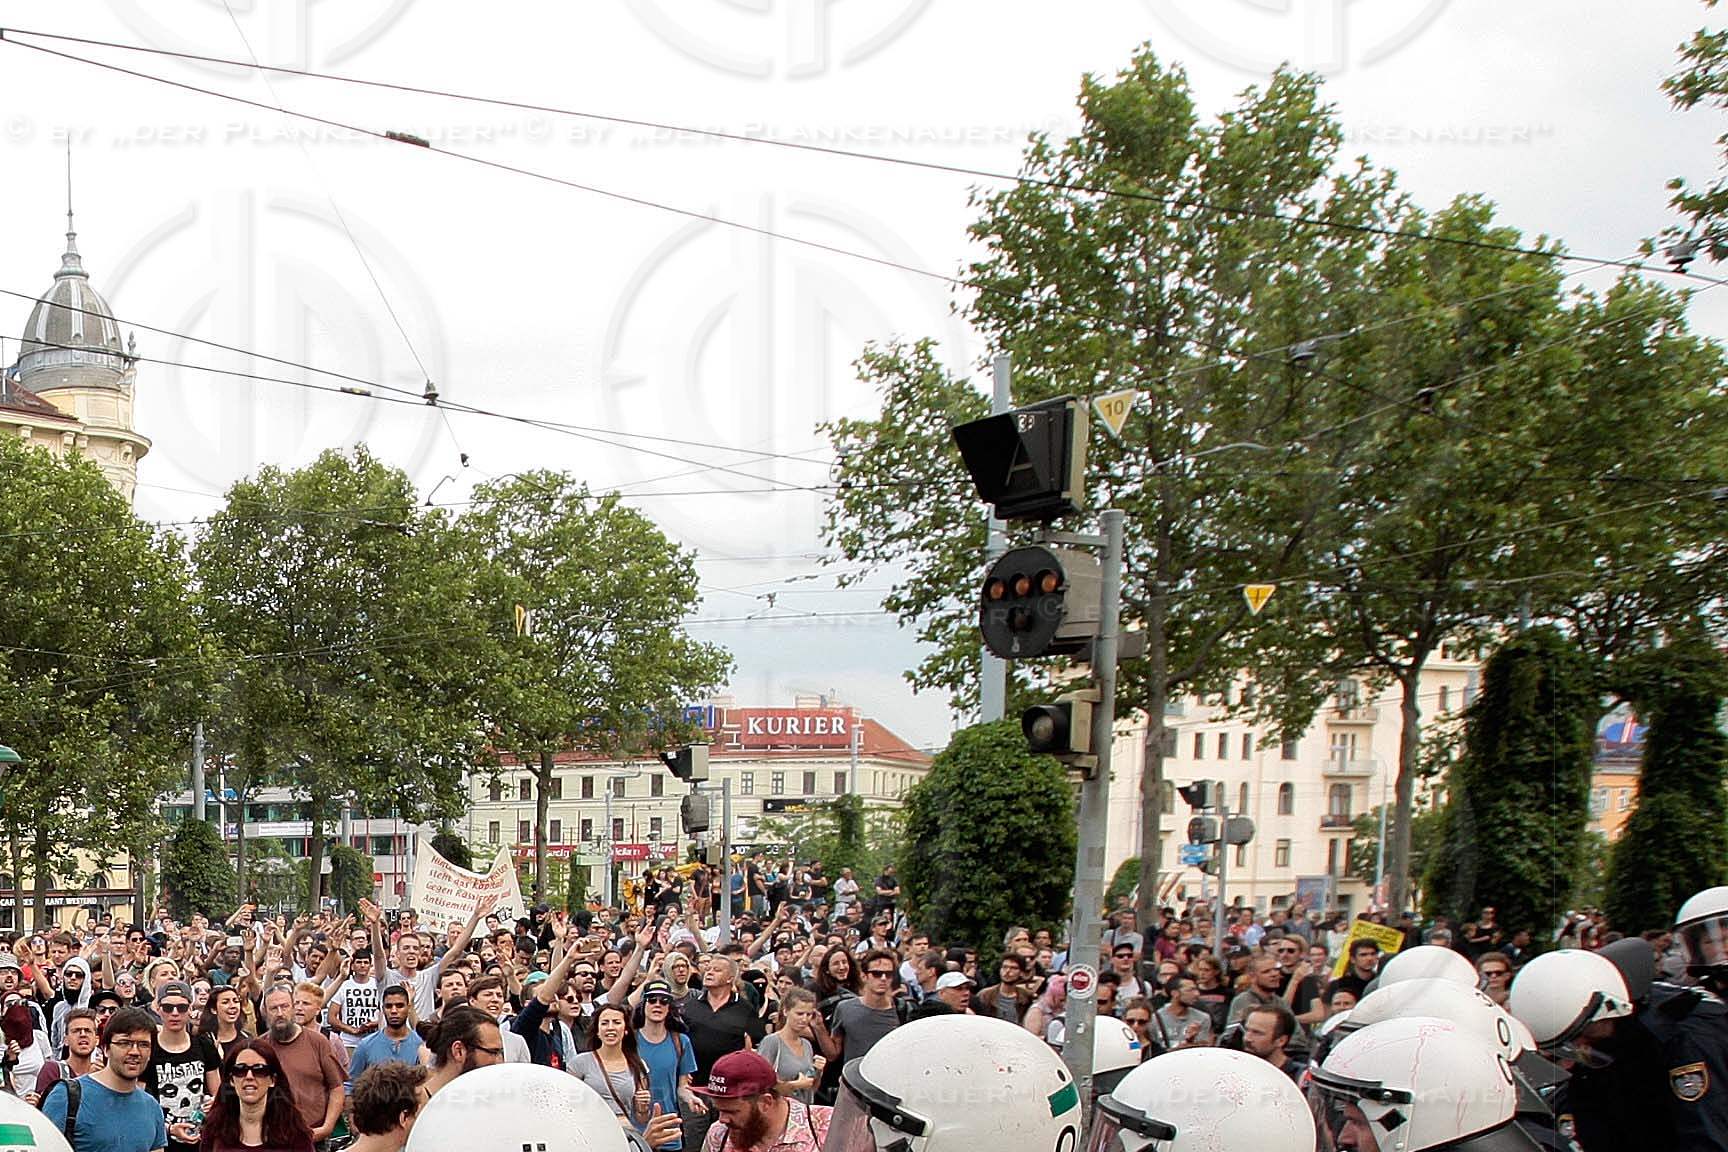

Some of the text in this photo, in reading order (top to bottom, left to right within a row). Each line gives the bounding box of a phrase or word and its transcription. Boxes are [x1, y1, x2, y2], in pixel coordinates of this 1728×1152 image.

[1105, 400, 1125, 417] 10
[747, 716, 847, 735] KURIER
[346, 998, 378, 1007] BALL
[347, 1008, 377, 1017] IS MY
[156, 1061, 205, 1082] MISFITS
